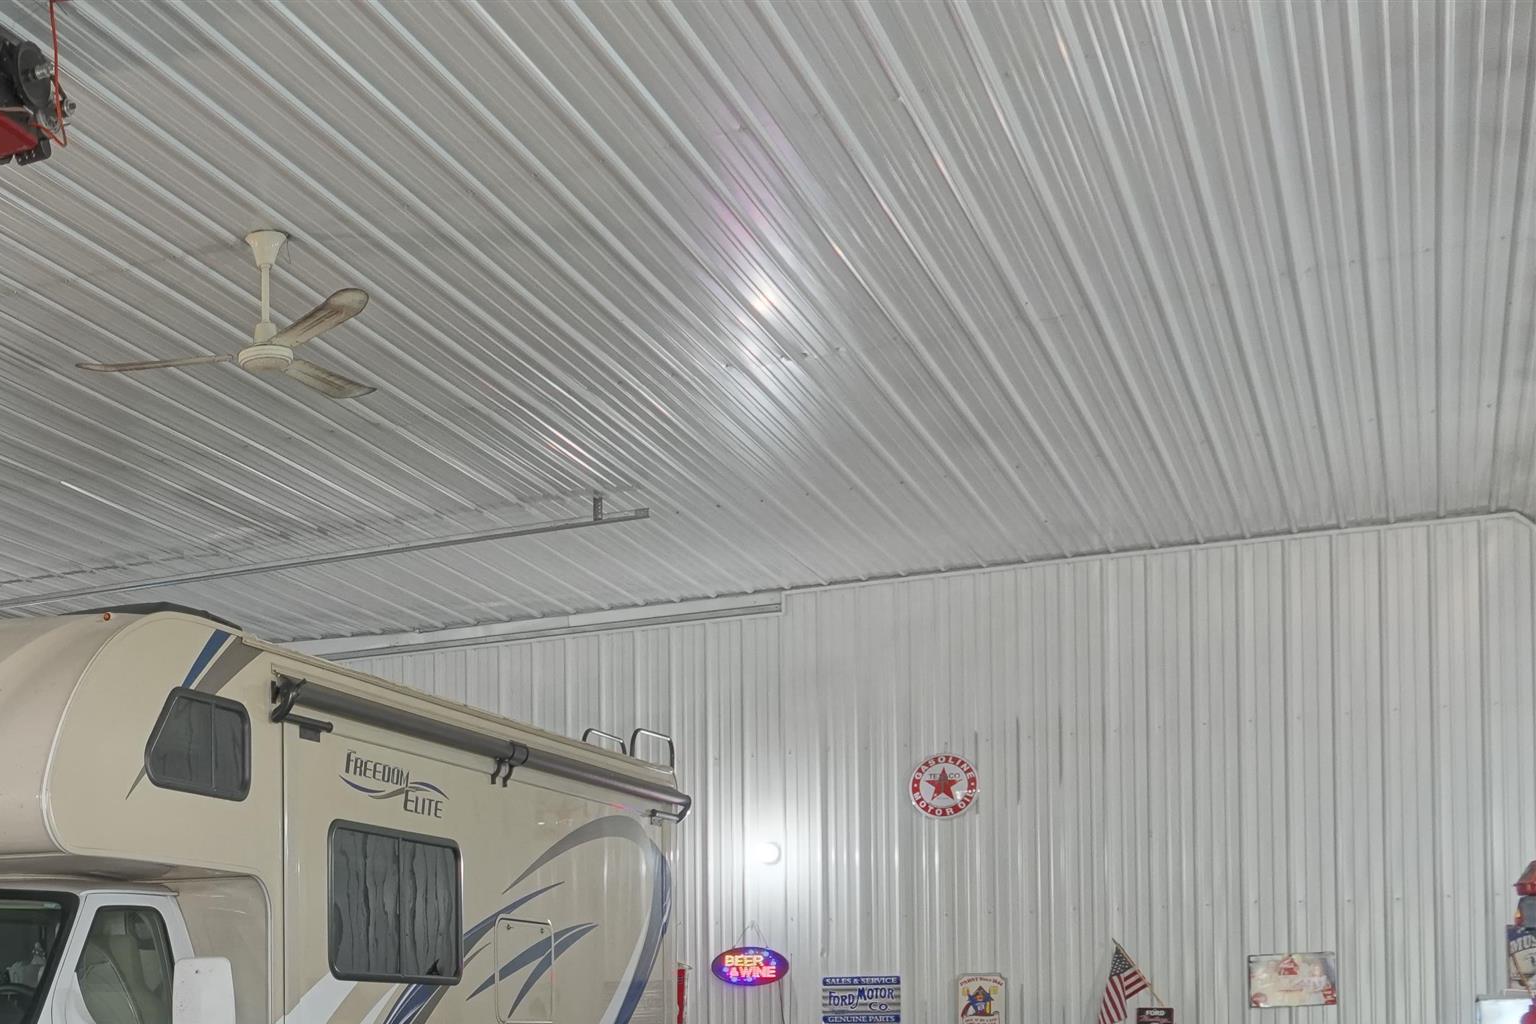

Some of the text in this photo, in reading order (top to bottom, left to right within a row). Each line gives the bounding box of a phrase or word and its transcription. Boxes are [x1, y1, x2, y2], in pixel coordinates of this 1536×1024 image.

[345, 749, 409, 788] FREEDOM
[915, 756, 975, 780] GASOLINE
[403, 789, 444, 819] ELITE
[913, 790, 974, 816] MOTOR OIL
[725, 954, 764, 966] BEER
[739, 965, 777, 978] WINE
[826, 977, 851, 985] SALES
[828, 987, 895, 1007] FORD MOTOR
